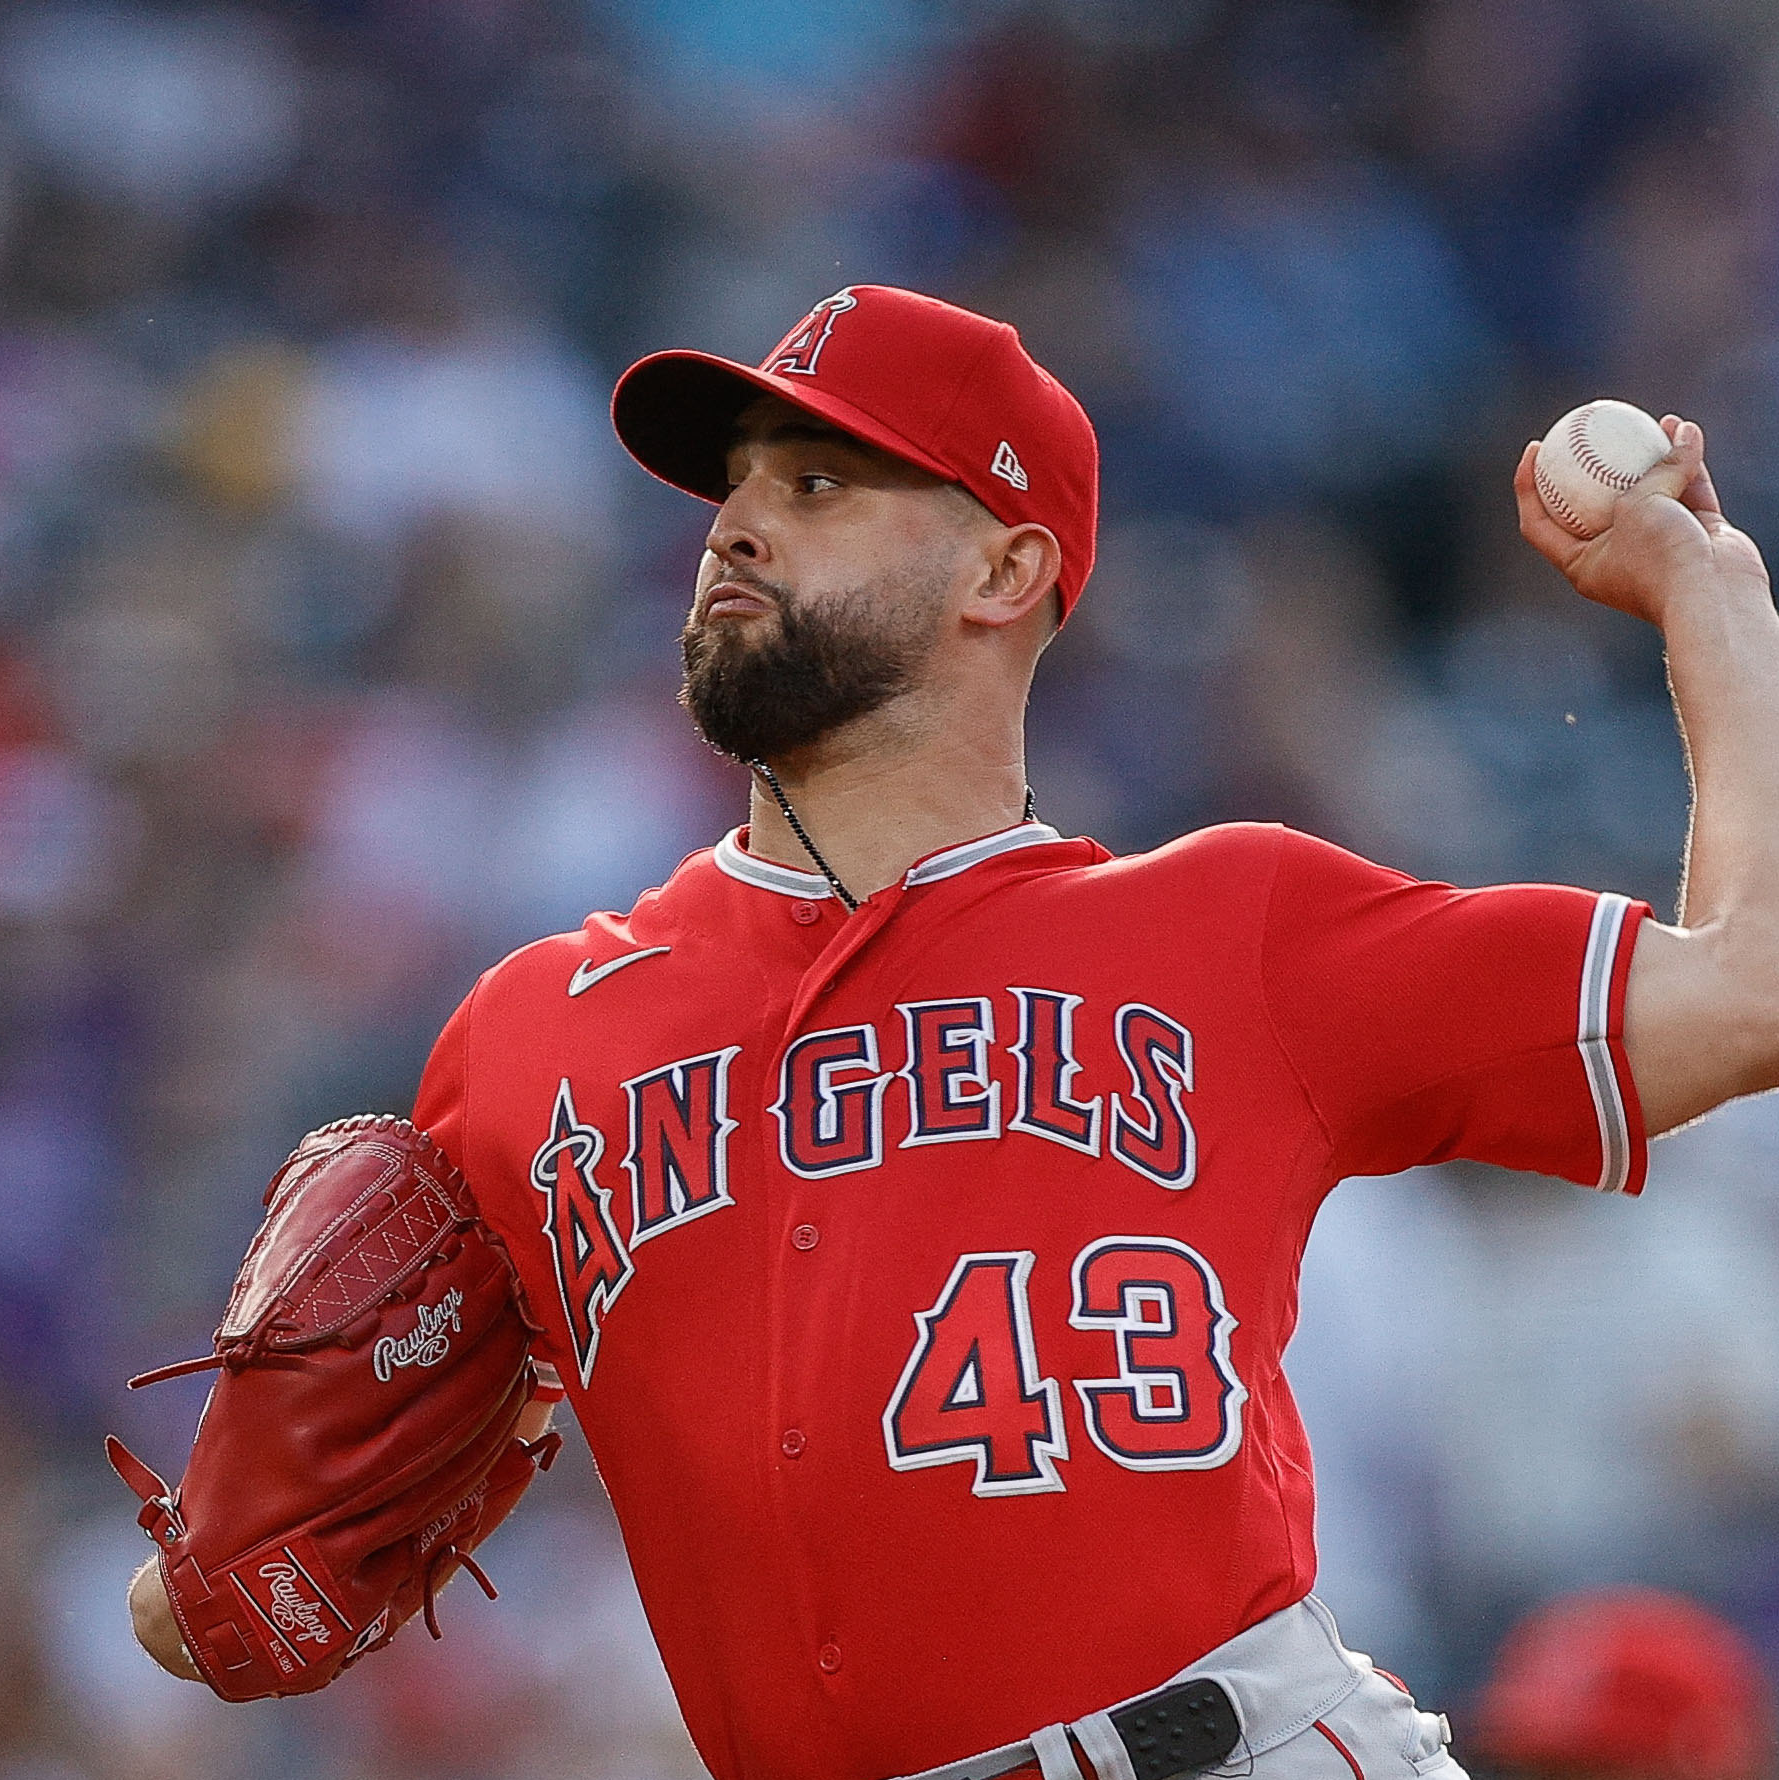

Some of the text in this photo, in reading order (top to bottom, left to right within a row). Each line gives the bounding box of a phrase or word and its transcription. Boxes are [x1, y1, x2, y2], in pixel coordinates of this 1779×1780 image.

[531, 987, 1196, 1390] ANGELS
[373, 1286, 463, 1382] Rawlings
[881, 1235, 1249, 1497] 43
[258, 1562, 332, 1644] Rawlings
